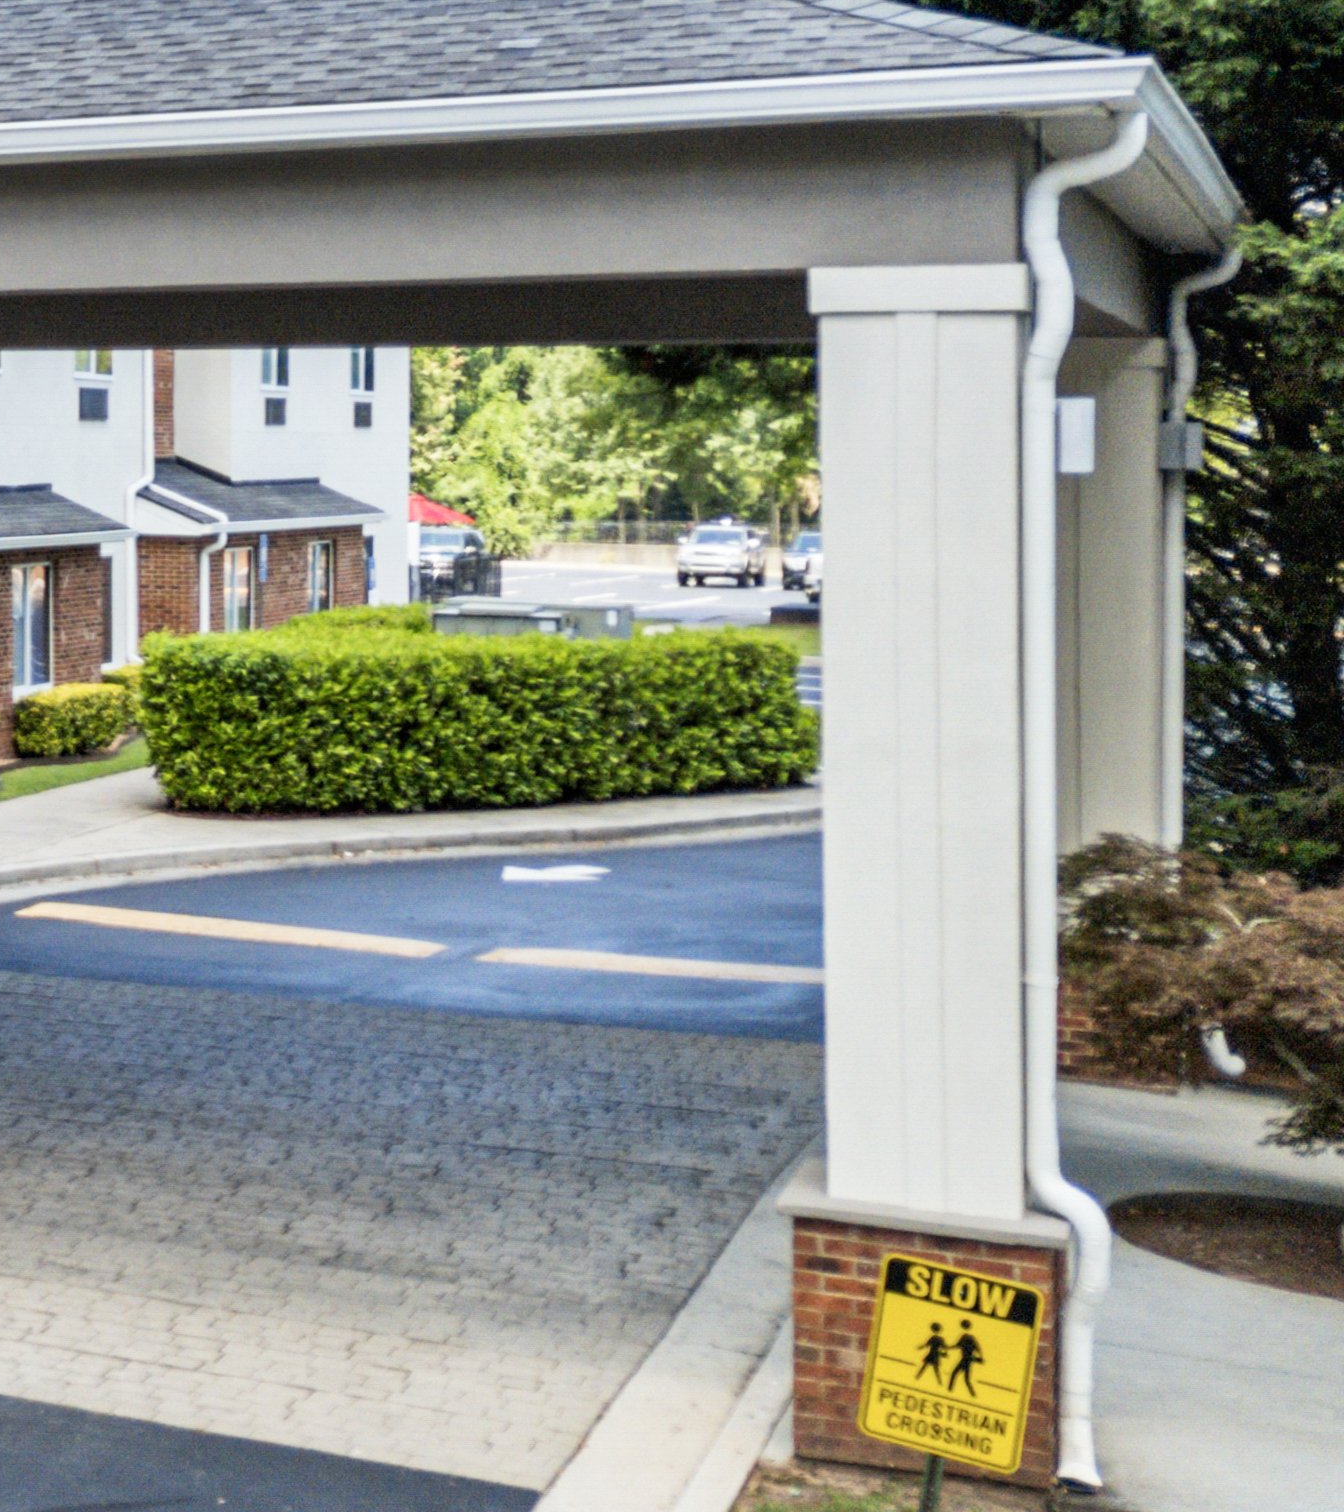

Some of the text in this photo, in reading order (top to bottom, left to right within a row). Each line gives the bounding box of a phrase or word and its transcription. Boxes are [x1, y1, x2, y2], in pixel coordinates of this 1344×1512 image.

[904, 1264, 1016, 1319] SLOW
[877, 1388, 1009, 1437] PEDESTRIAN
[884, 1412, 993, 1456] CROSSING
